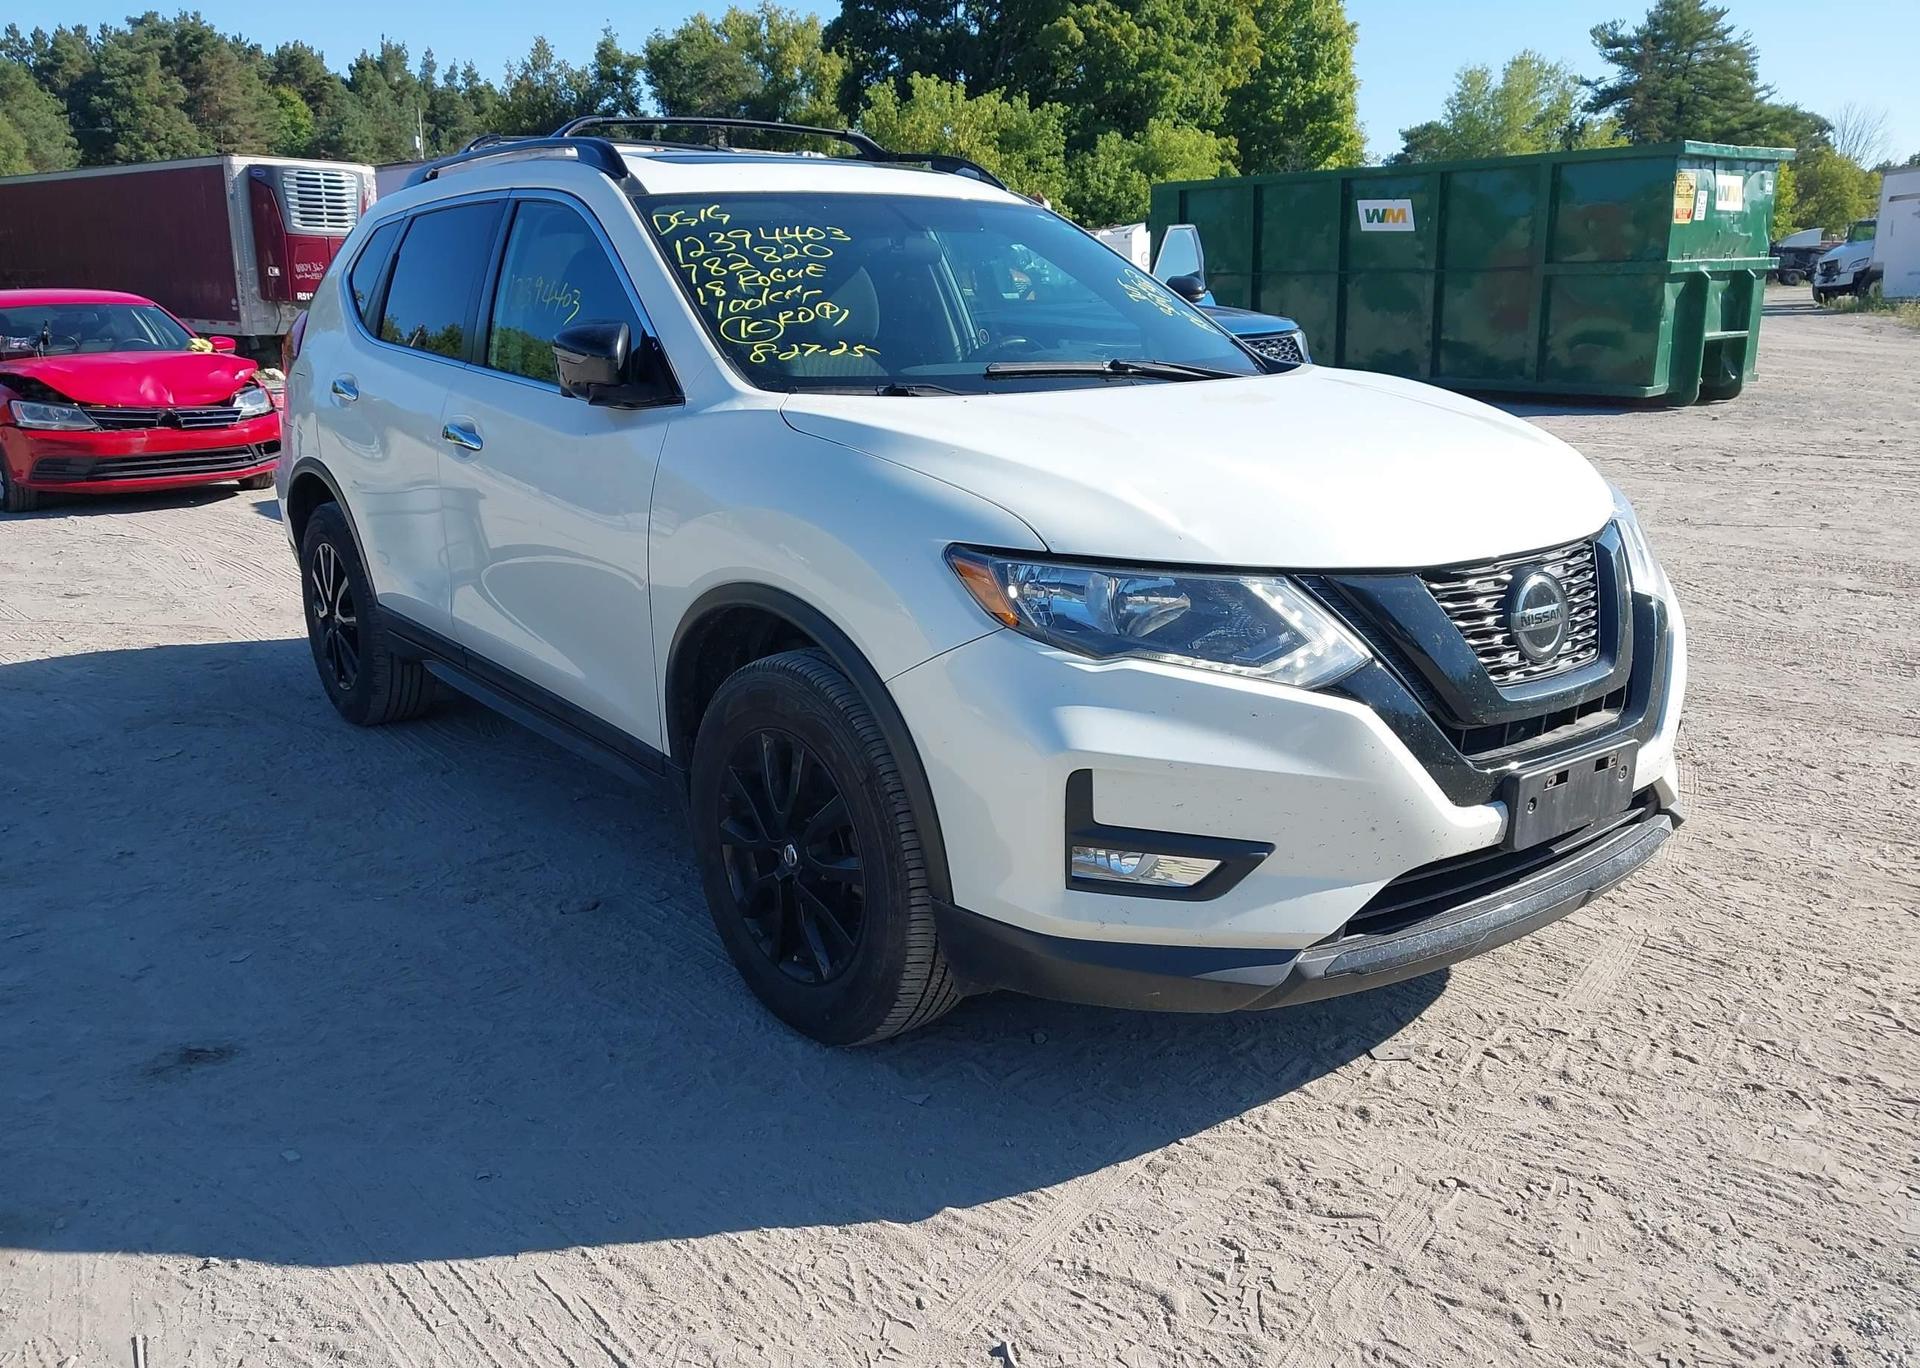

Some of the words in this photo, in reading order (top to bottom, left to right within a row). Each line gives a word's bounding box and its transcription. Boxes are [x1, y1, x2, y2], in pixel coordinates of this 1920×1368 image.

[1718, 184, 1740, 202] WM
[1365, 208, 1407, 224] WM
[697, 281, 726, 305] 18
[738, 264, 826, 293] ROGUE
[1520, 609, 1562, 627] NISSAN
